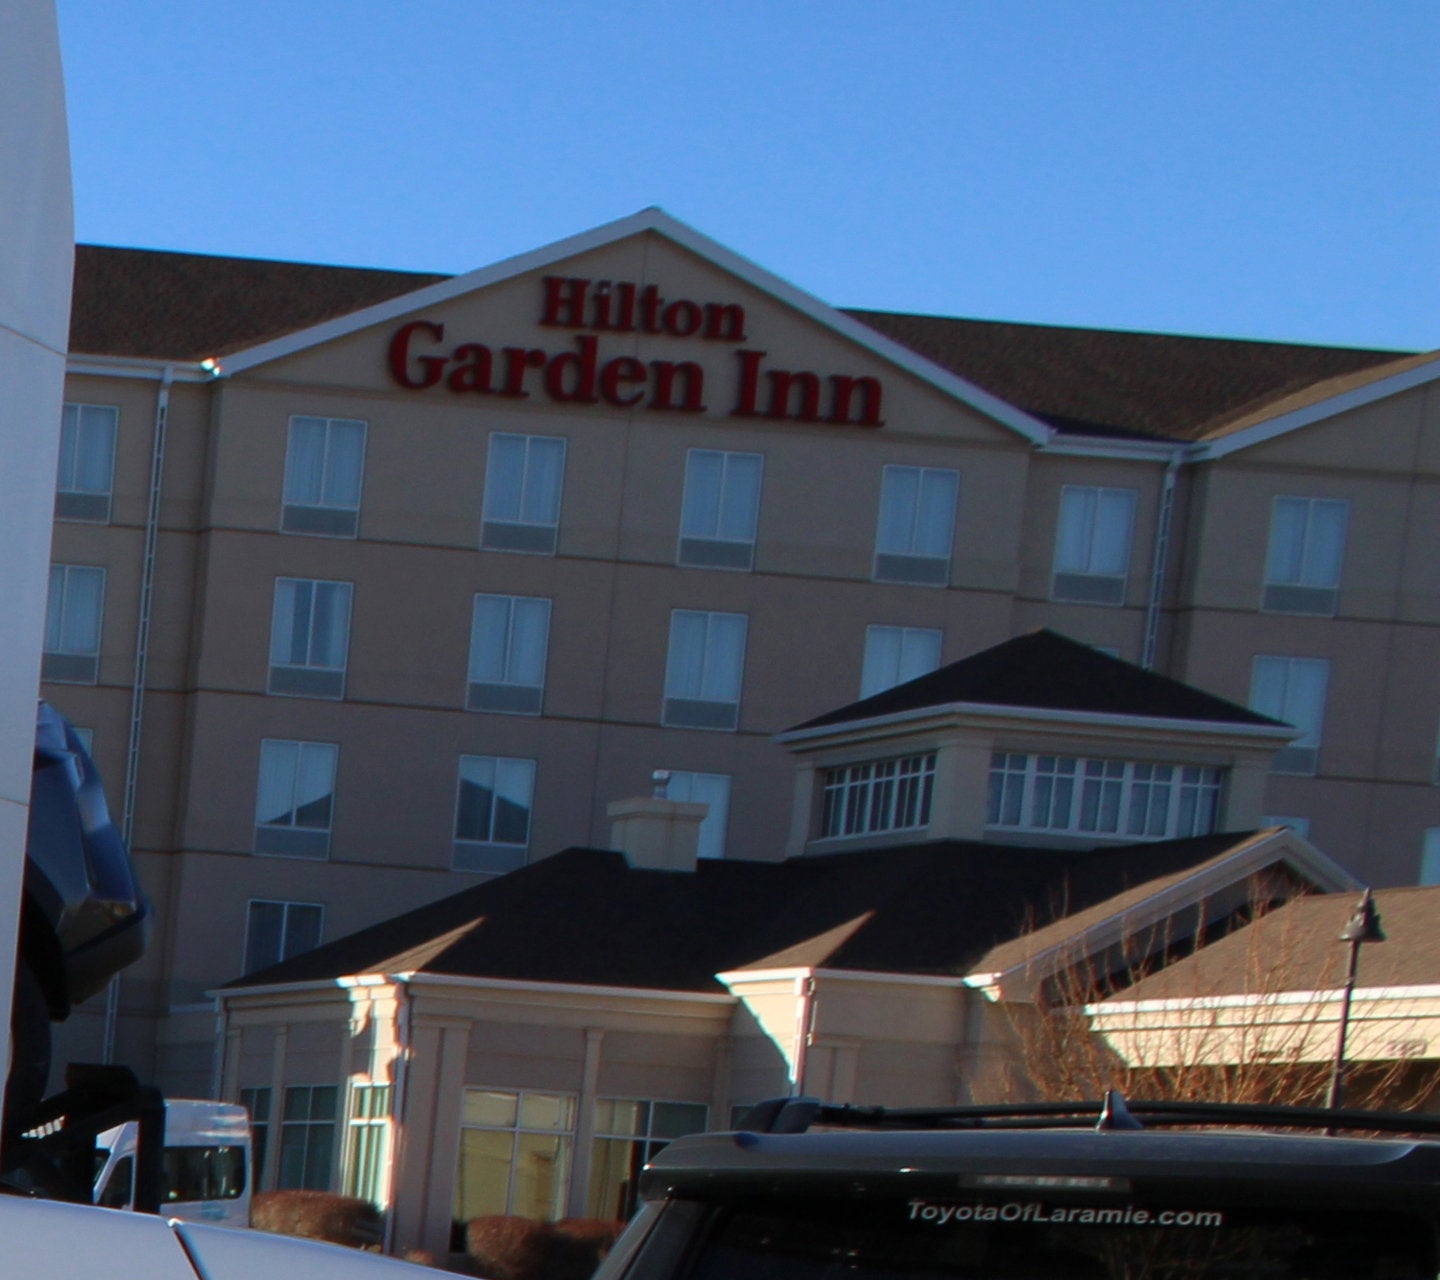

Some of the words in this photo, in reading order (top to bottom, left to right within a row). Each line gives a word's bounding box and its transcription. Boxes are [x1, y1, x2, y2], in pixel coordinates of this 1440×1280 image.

[539, 274, 748, 343] Hilton
[387, 319, 708, 415] Garden
[730, 348, 887, 429] Inn
[907, 1200, 1223, 1227] ToyotaOfLaramie.com
